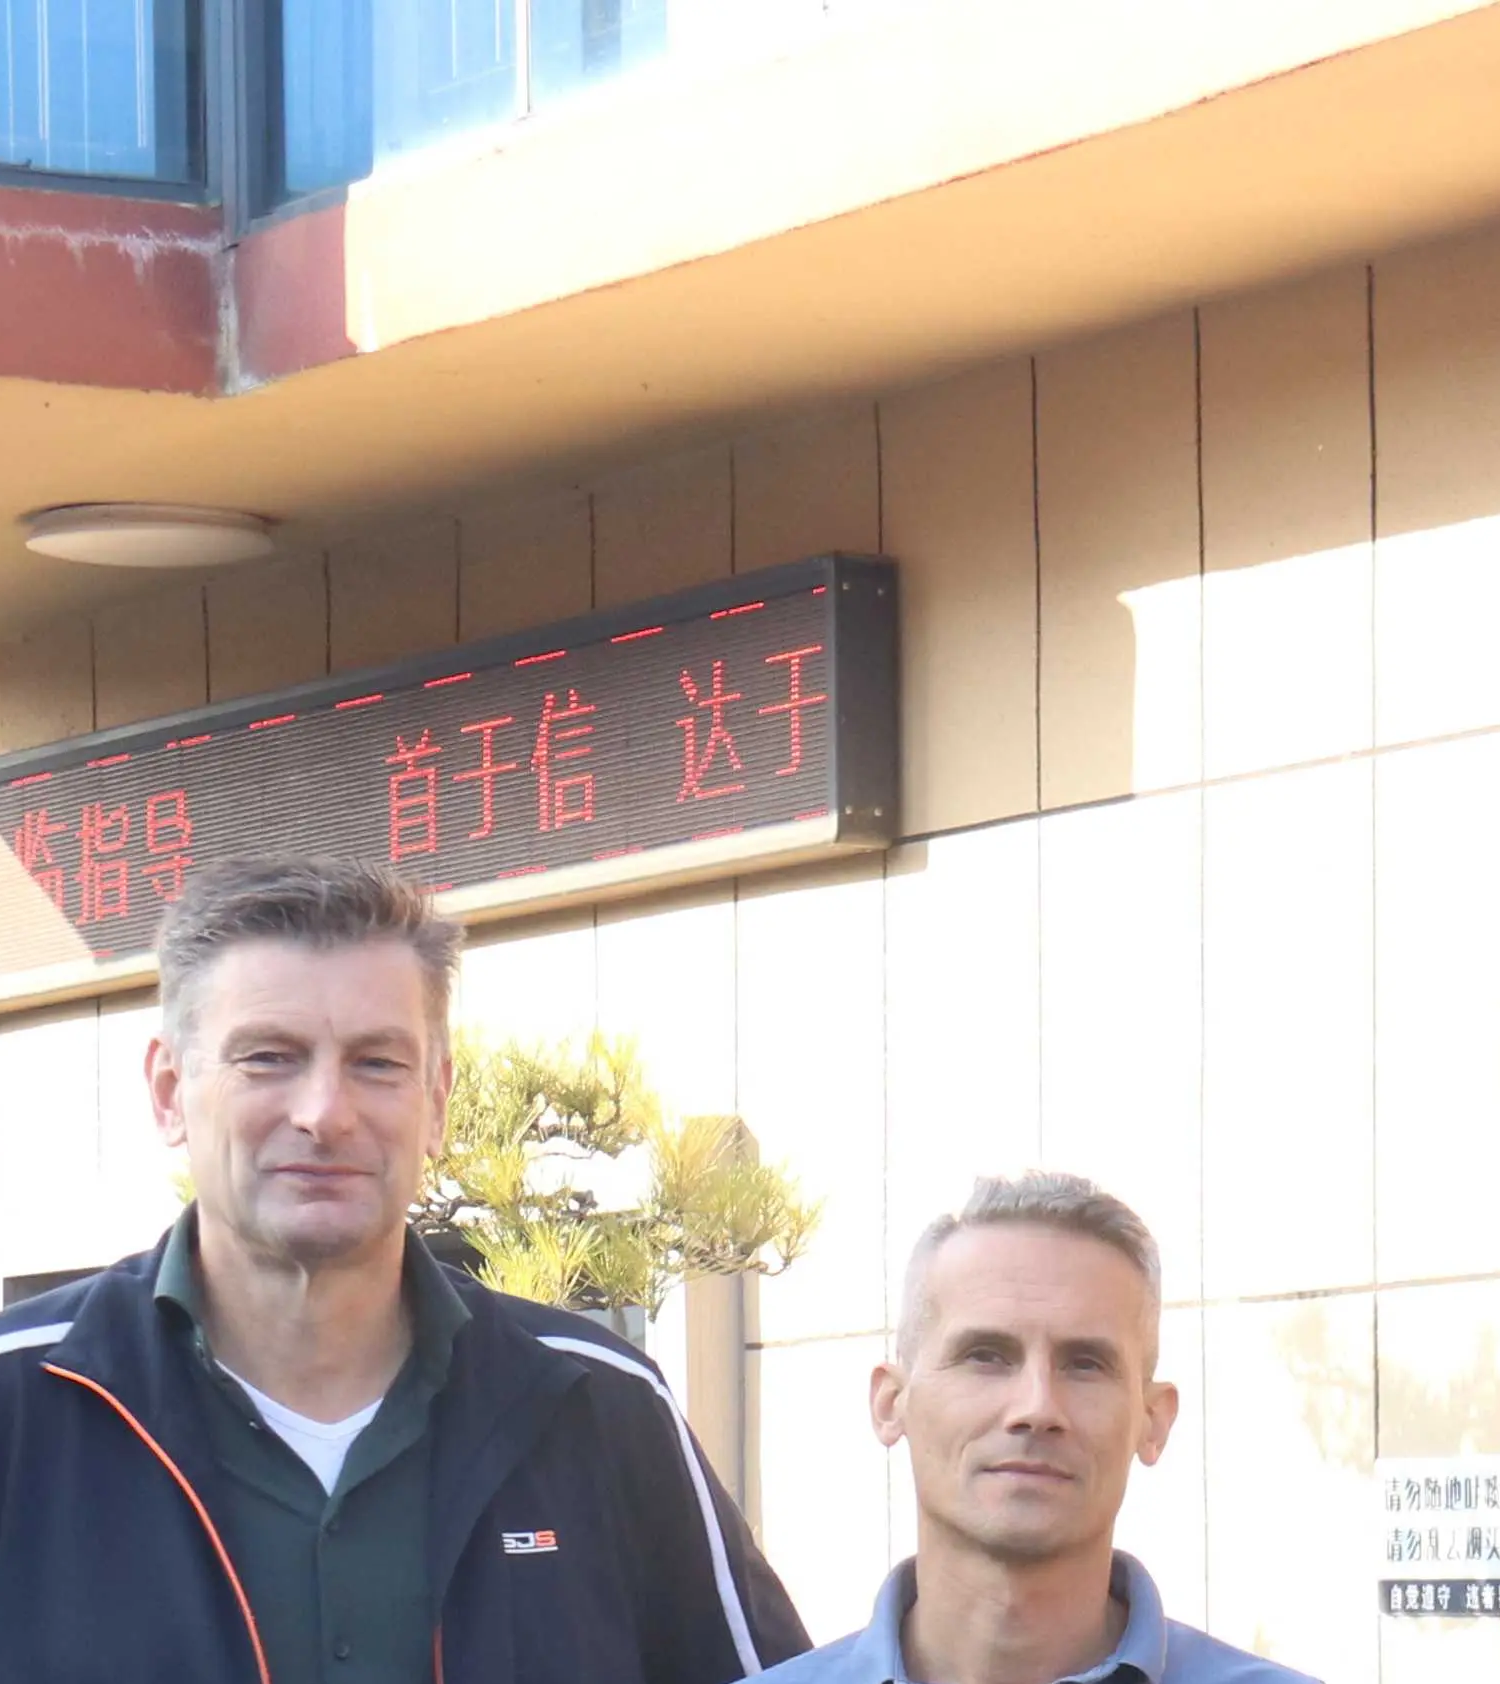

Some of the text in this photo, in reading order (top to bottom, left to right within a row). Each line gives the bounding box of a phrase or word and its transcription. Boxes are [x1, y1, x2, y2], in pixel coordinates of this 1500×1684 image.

[384, 689, 598, 861] 首于信
[675, 645, 829, 803] 达于
